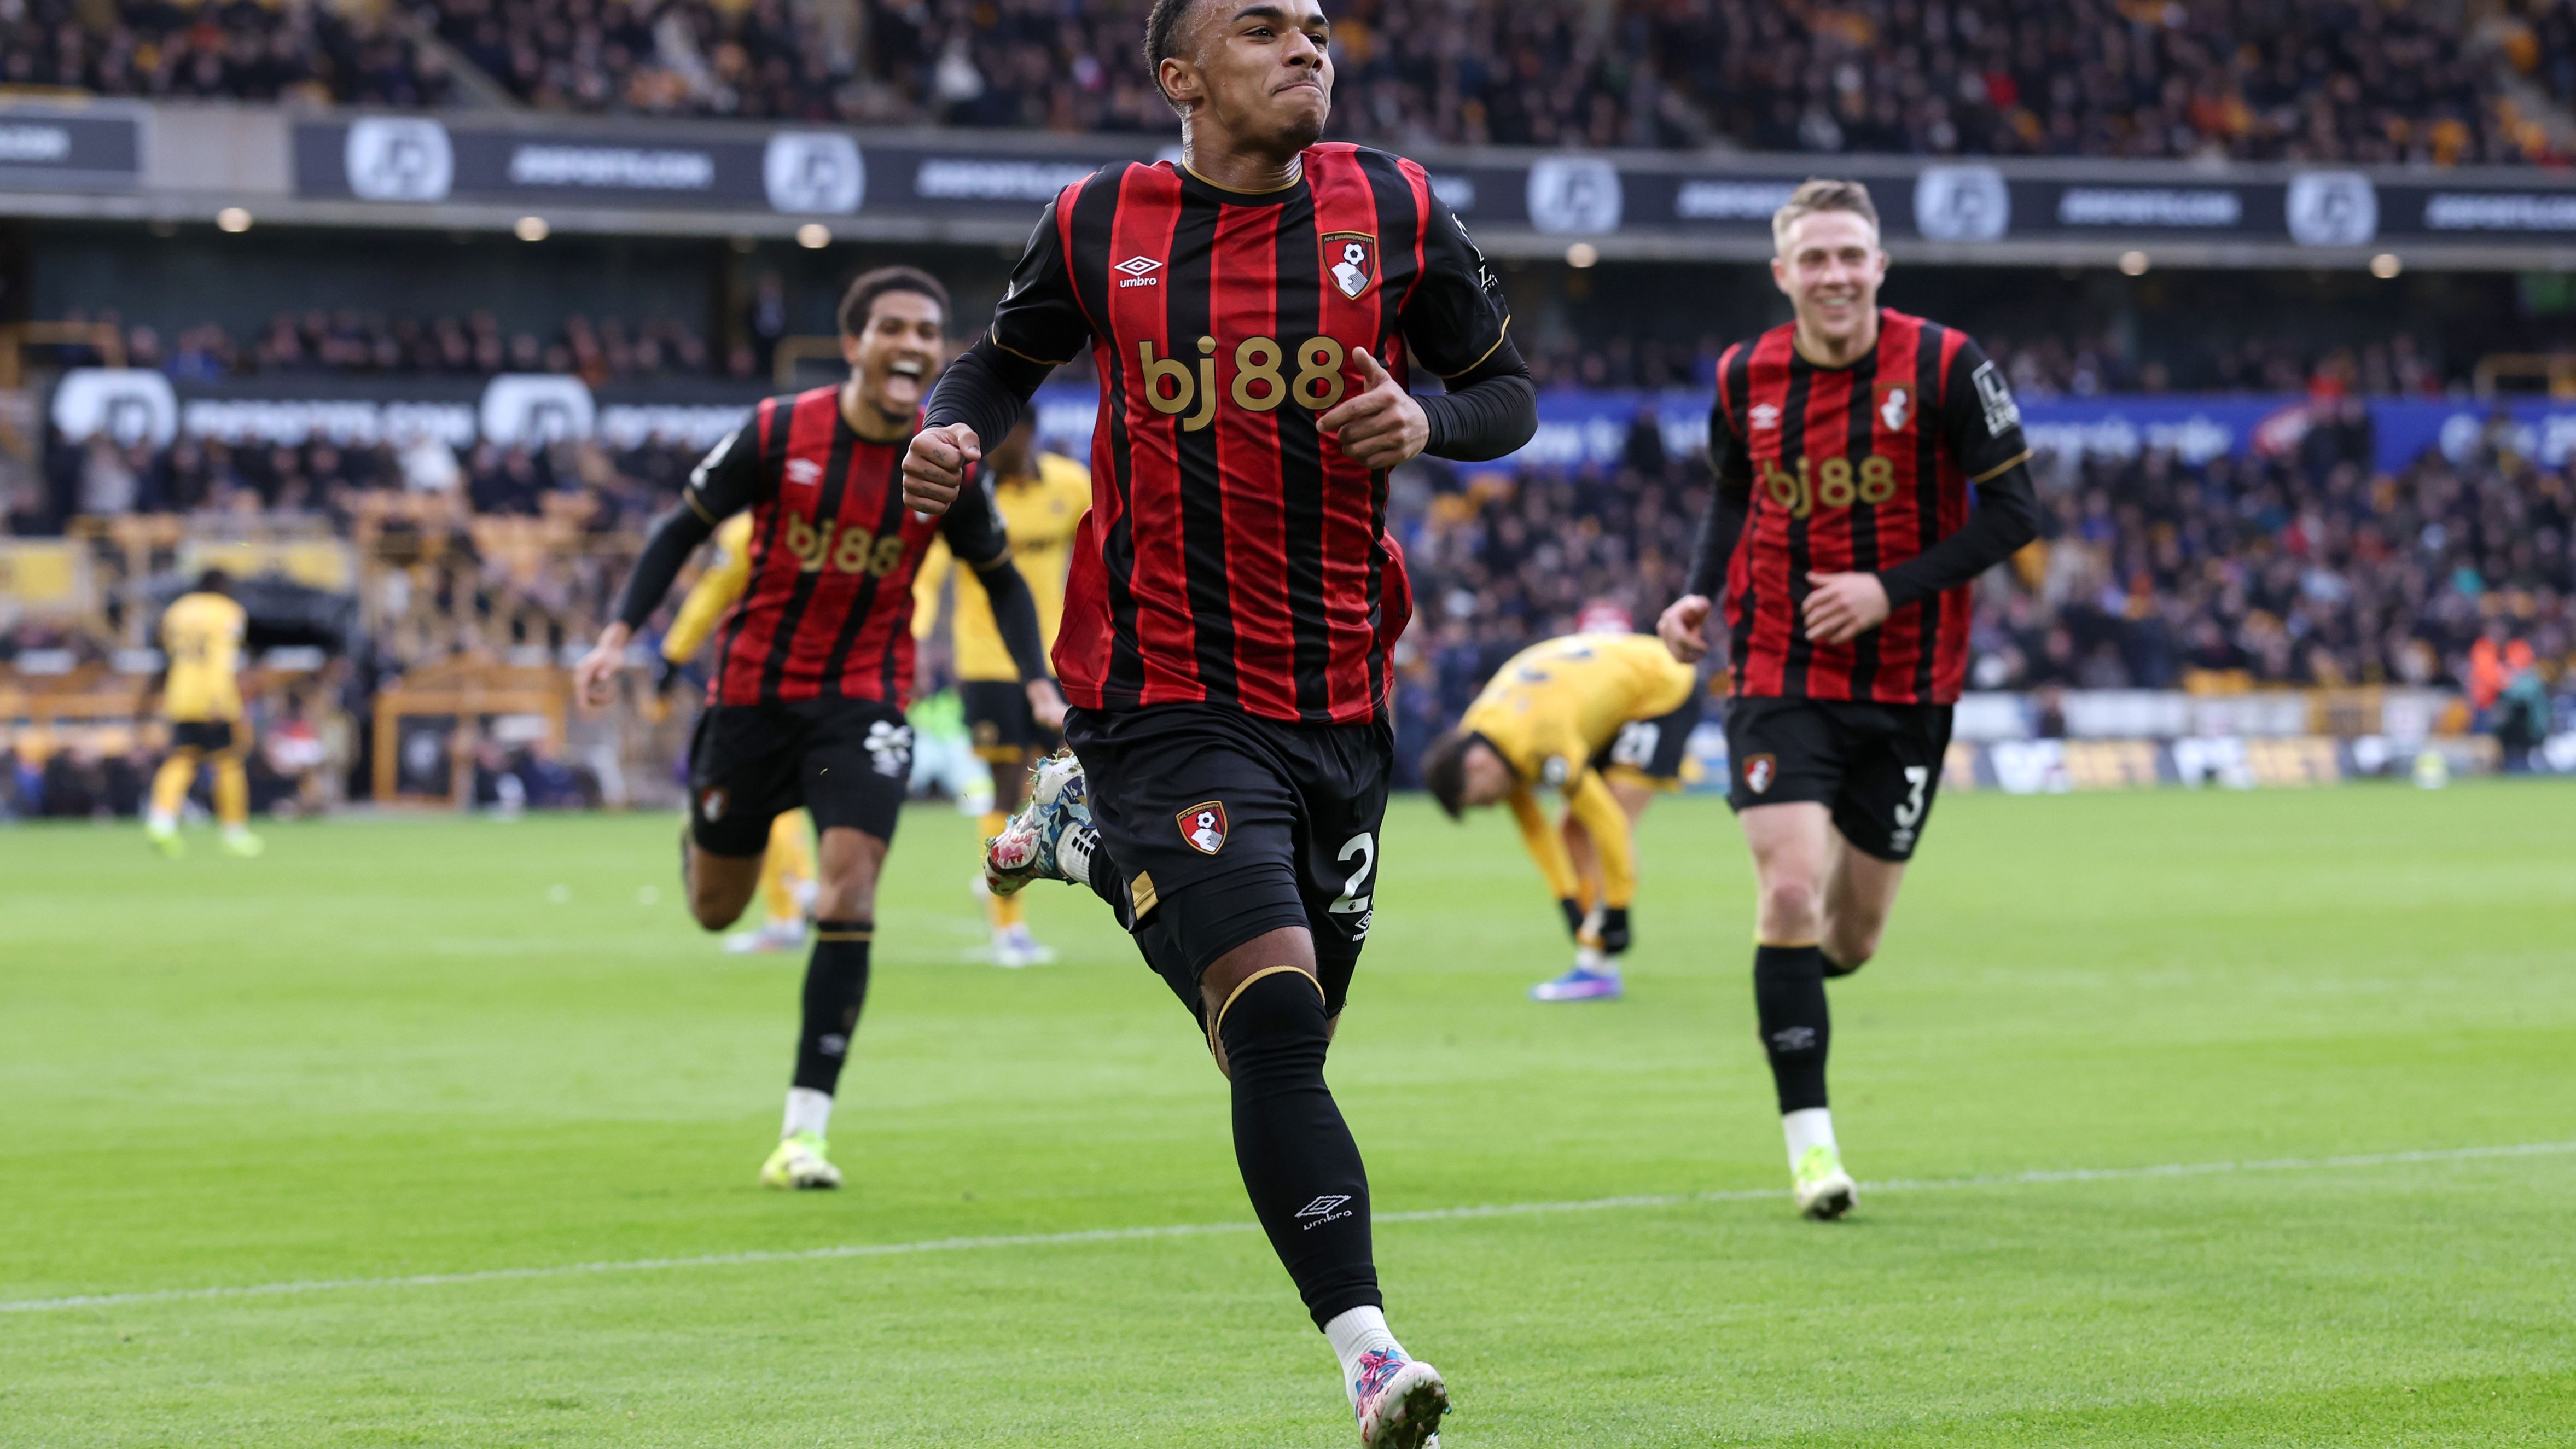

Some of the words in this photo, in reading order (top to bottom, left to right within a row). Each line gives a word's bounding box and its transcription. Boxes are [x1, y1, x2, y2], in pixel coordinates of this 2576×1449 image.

[1335, 234, 1373, 243] BOURNEMOUTH
[1120, 276, 1157, 288] umbro
[1139, 335, 1345, 432] bj88
[1764, 454, 1896, 518] bj88
[786, 511, 907, 578] bj88
[1894, 766, 1929, 828] 3
[1328, 832, 1376, 913] 2
